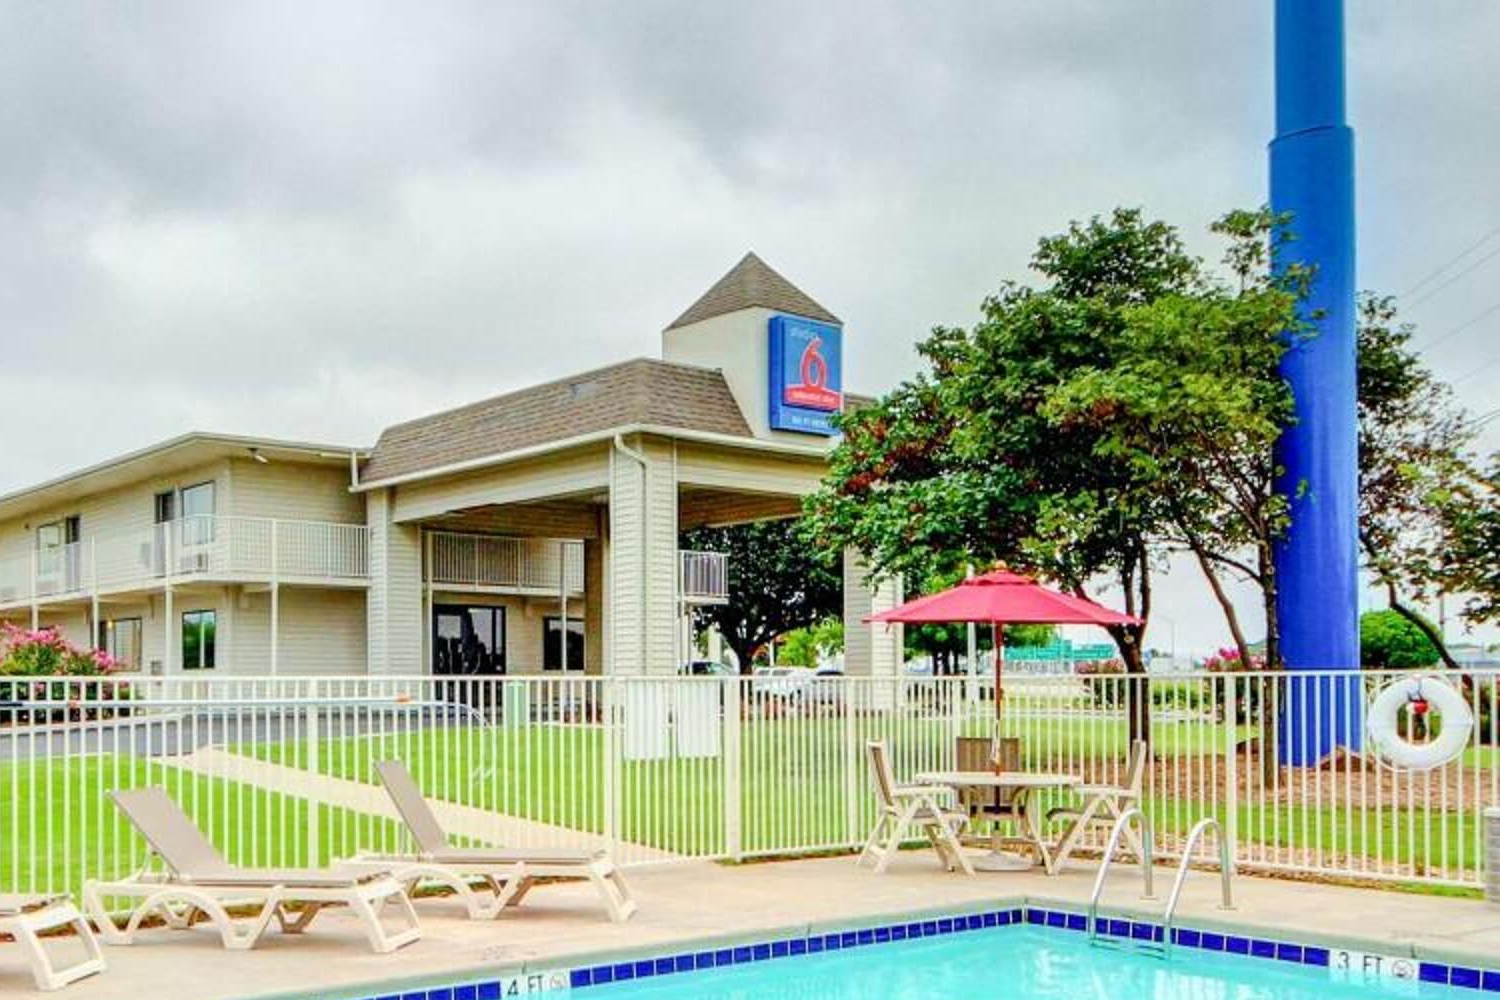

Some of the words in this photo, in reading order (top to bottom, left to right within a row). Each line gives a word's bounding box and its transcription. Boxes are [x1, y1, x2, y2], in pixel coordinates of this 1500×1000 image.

[800, 336, 828, 389] 6
[1338, 951, 1349, 970] 3
[1363, 955, 1382, 975] FT
[507, 979, 519, 996] 4
[527, 975, 544, 994] FT
